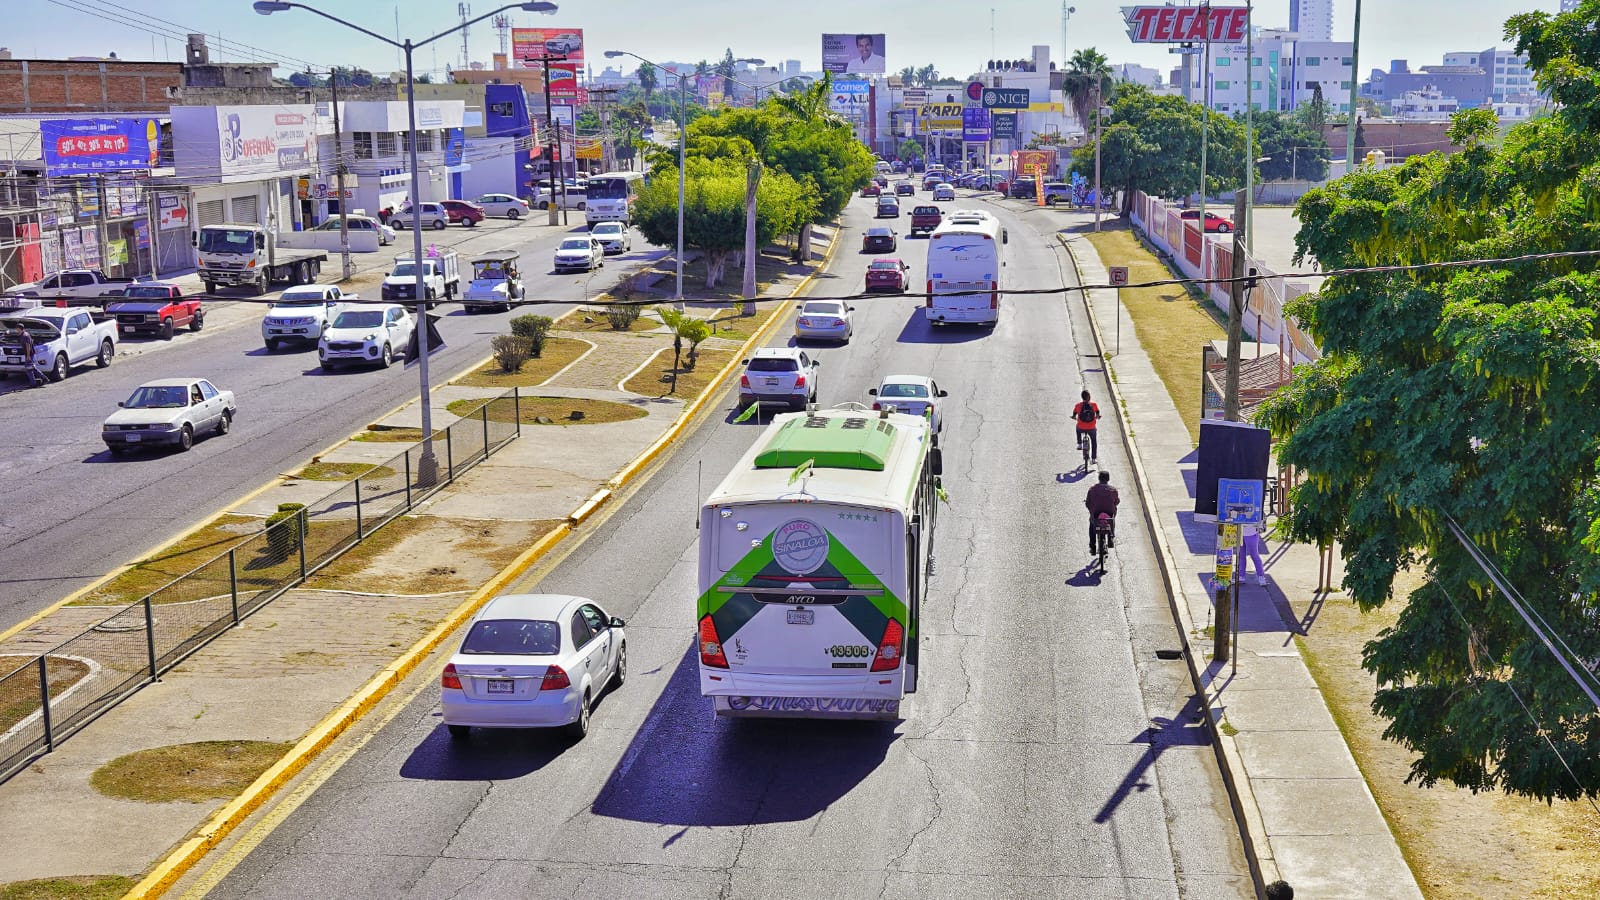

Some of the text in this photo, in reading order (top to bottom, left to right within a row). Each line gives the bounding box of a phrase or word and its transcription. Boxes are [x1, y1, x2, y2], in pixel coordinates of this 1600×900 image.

[1134, 8, 1249, 40] TECATE
[834, 83, 865, 92] Comex
[999, 93, 1028, 105] NICE
[782, 523, 811, 534] PURO
[775, 536, 825, 555] SINALOA
[786, 595, 815, 604] AYCO
